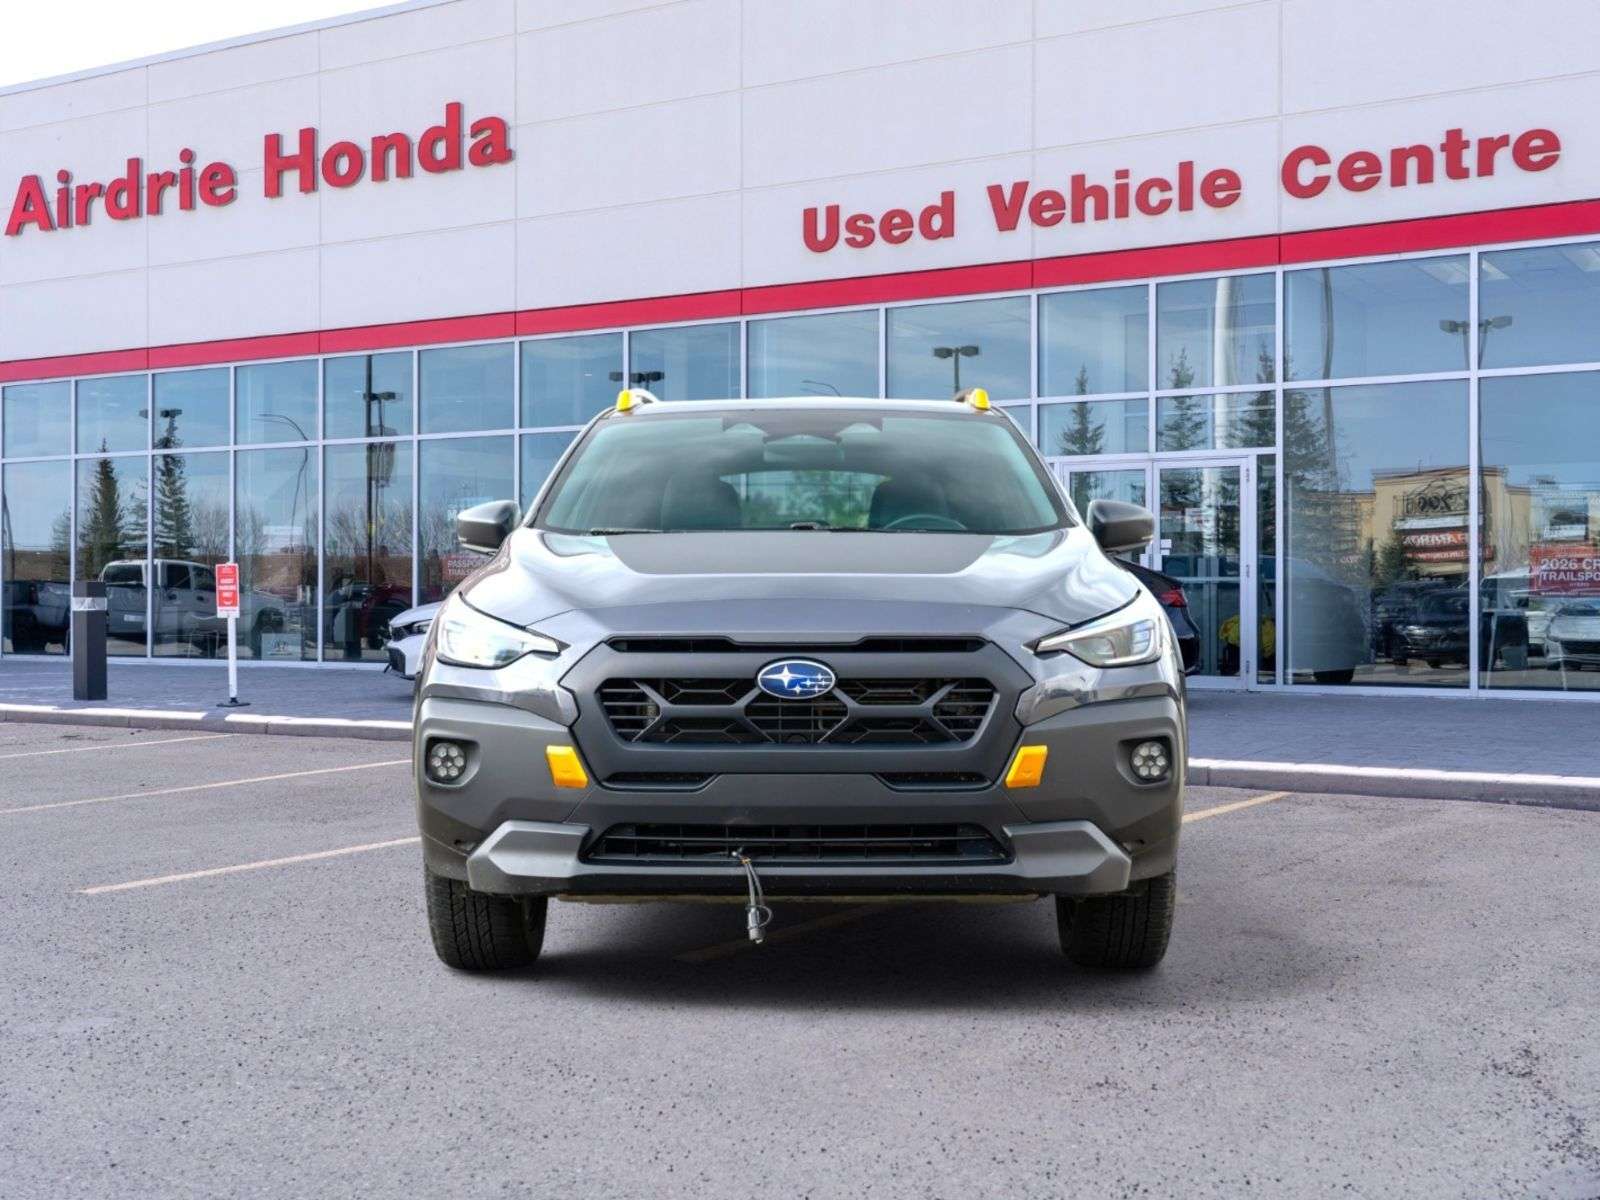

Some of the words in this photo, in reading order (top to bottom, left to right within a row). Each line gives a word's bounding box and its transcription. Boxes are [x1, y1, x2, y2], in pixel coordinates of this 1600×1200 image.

[6, 148, 237, 236] Airdrie
[264, 102, 512, 198] Honda
[803, 191, 955, 252] Used
[987, 161, 1242, 232] Vehicle
[1281, 128, 1561, 198] Centre
[1541, 558, 1578, 570] 2026
